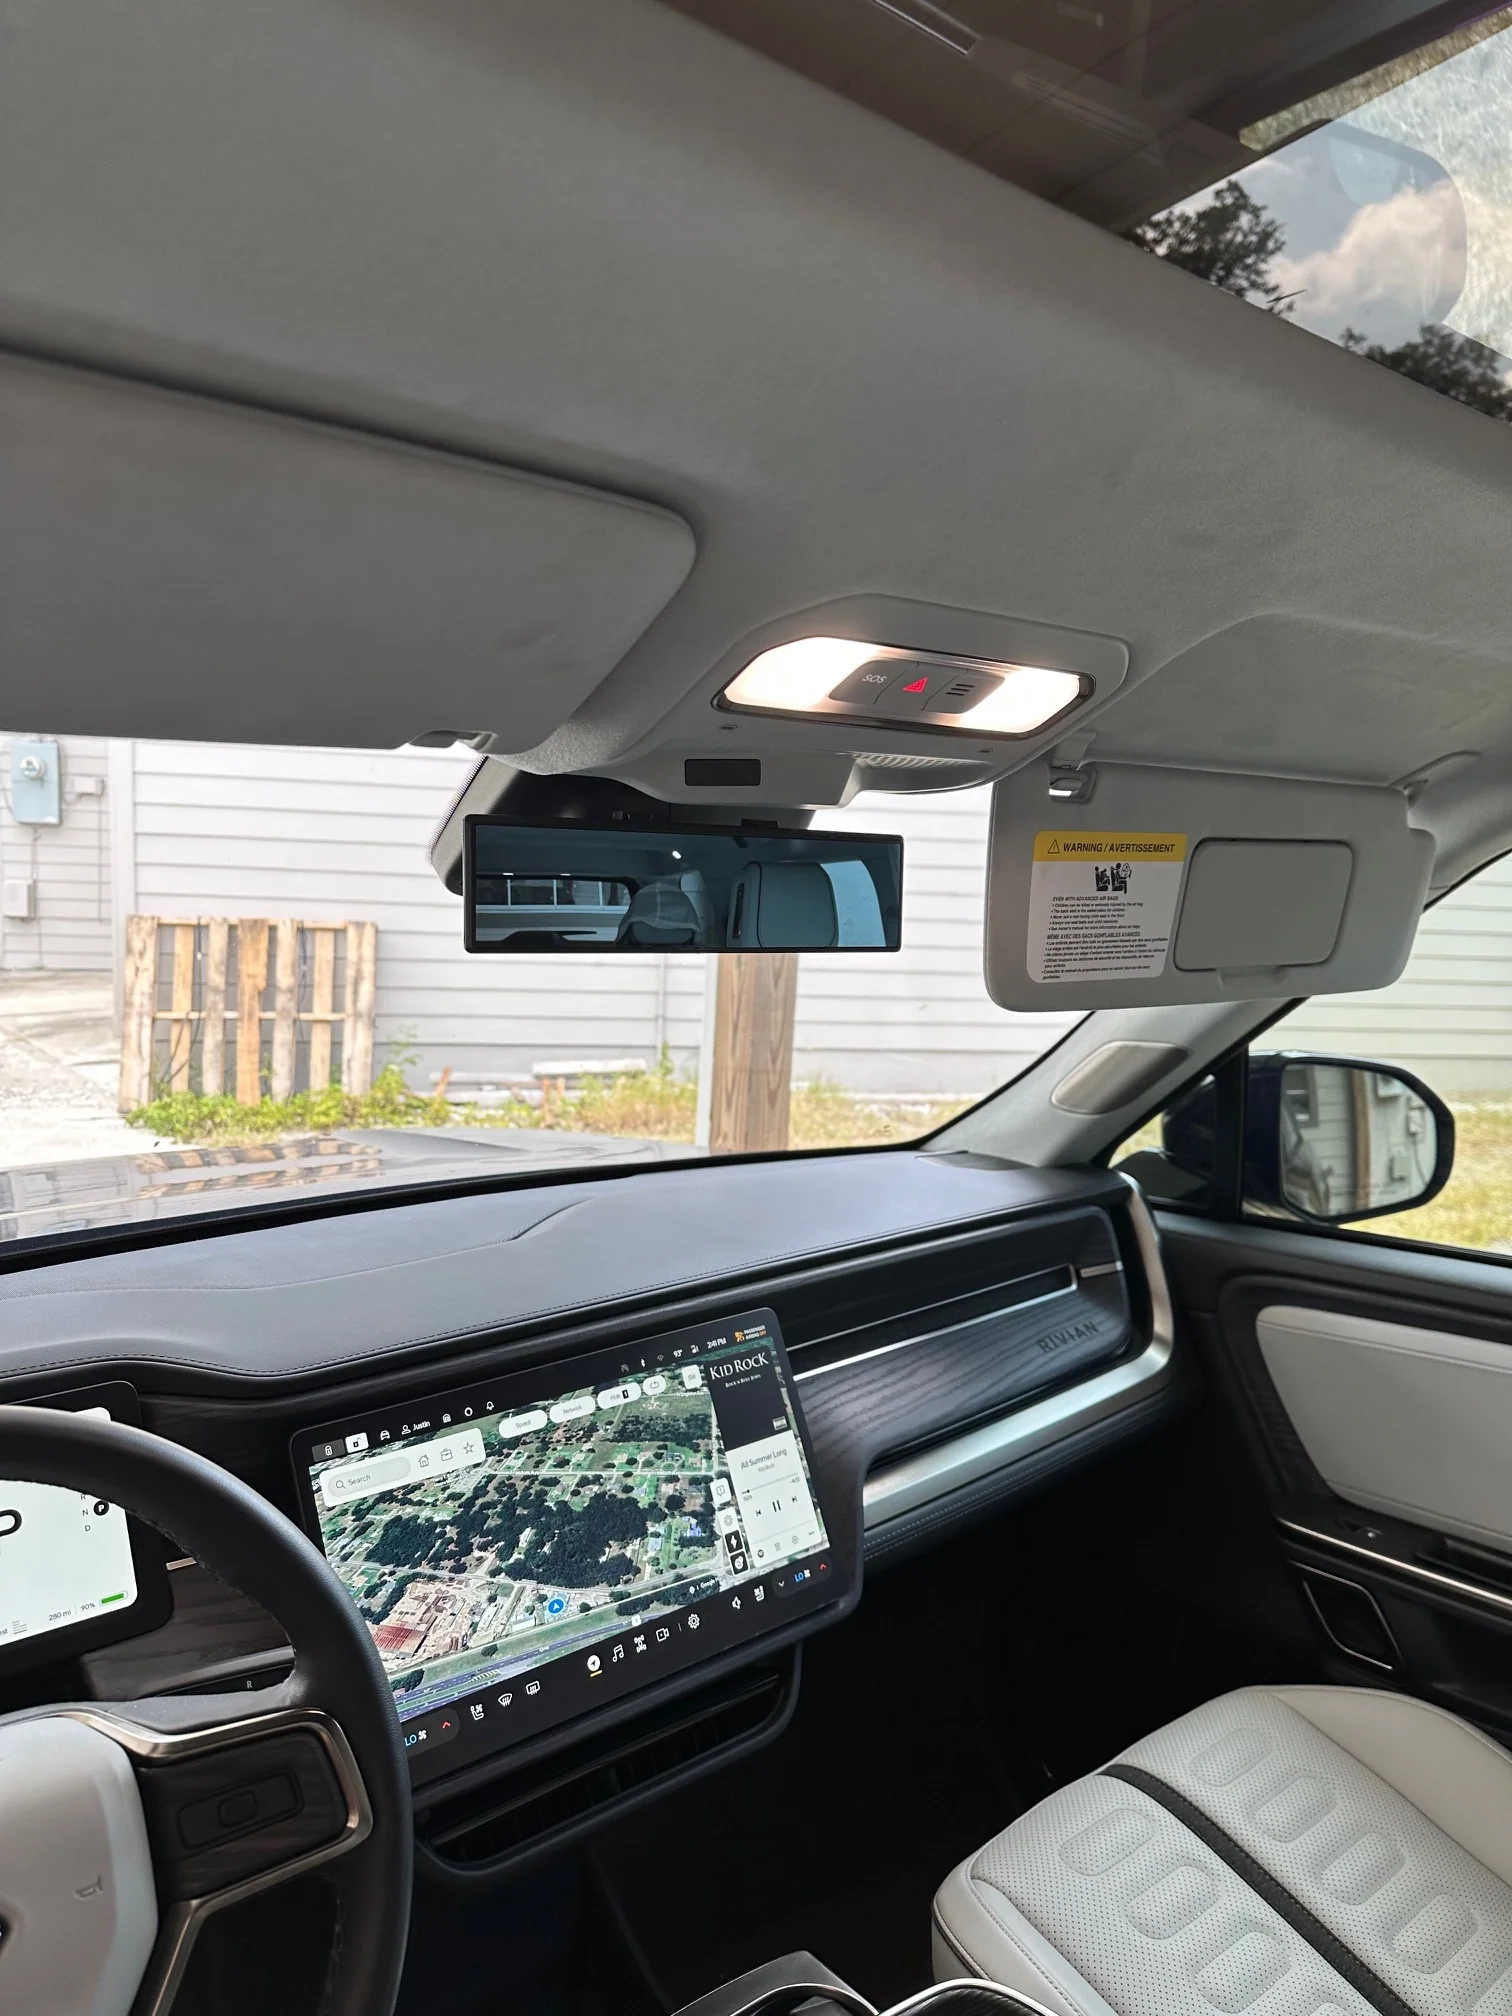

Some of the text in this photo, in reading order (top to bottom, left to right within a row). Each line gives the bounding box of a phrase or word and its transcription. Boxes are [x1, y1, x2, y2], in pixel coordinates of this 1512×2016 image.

[862, 674, 887, 684] SOS
[1063, 842, 1102, 852] WARNING
[1108, 843, 1176, 853] AVERTISSEMENT
[717, 1337, 727, 1346] PM
[1037, 1320, 1100, 1354] RIVIAN
[710, 1352, 769, 1380] KID ROCK
[563, 1404, 582, 1414] Network
[412, 1420, 431, 1431] Justin
[516, 1415, 531, 1428] Speed
[749, 1454, 772, 1466] Summer
[772, 1449, 787, 1458] Long
[348, 1474, 371, 1486] Search
[794, 1572, 804, 1582] LO
[80, 1602, 95, 1611] 90%
[49, 1609, 71, 1621] 280 mi
[246, 1680, 253, 1689] R
[404, 1734, 417, 1746] LO
